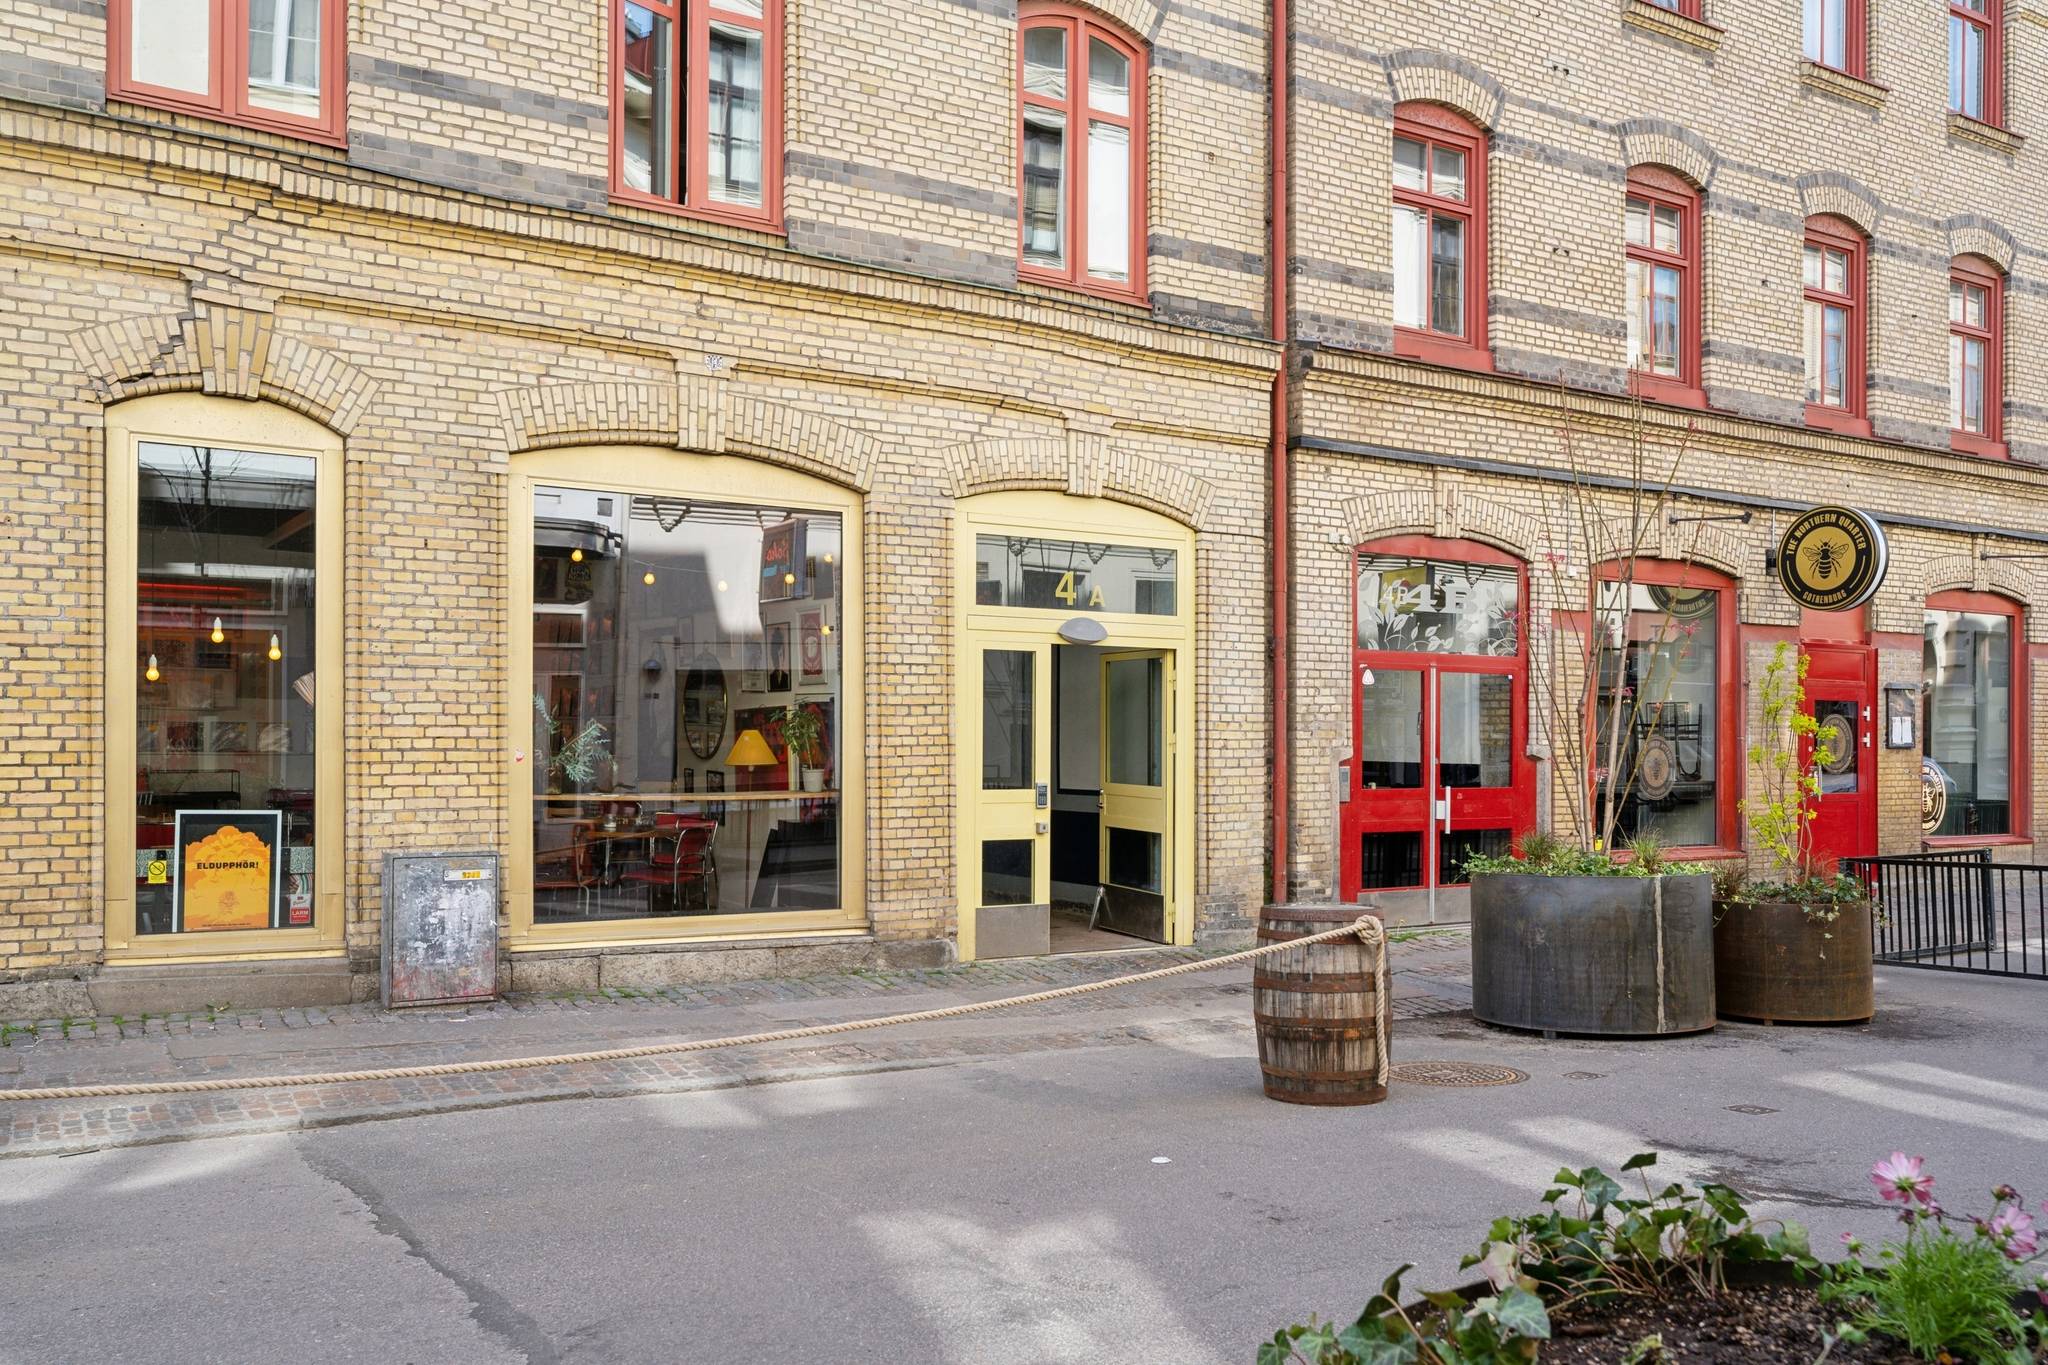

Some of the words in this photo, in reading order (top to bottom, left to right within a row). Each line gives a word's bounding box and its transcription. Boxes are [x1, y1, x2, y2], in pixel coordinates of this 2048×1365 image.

[1786, 536, 1799, 555] THE
[1794, 513, 1838, 538] NORTHERN
[1838, 516, 1867, 550] QUARTER
[196, 861, 259, 870] ELDUPPHÖR!
